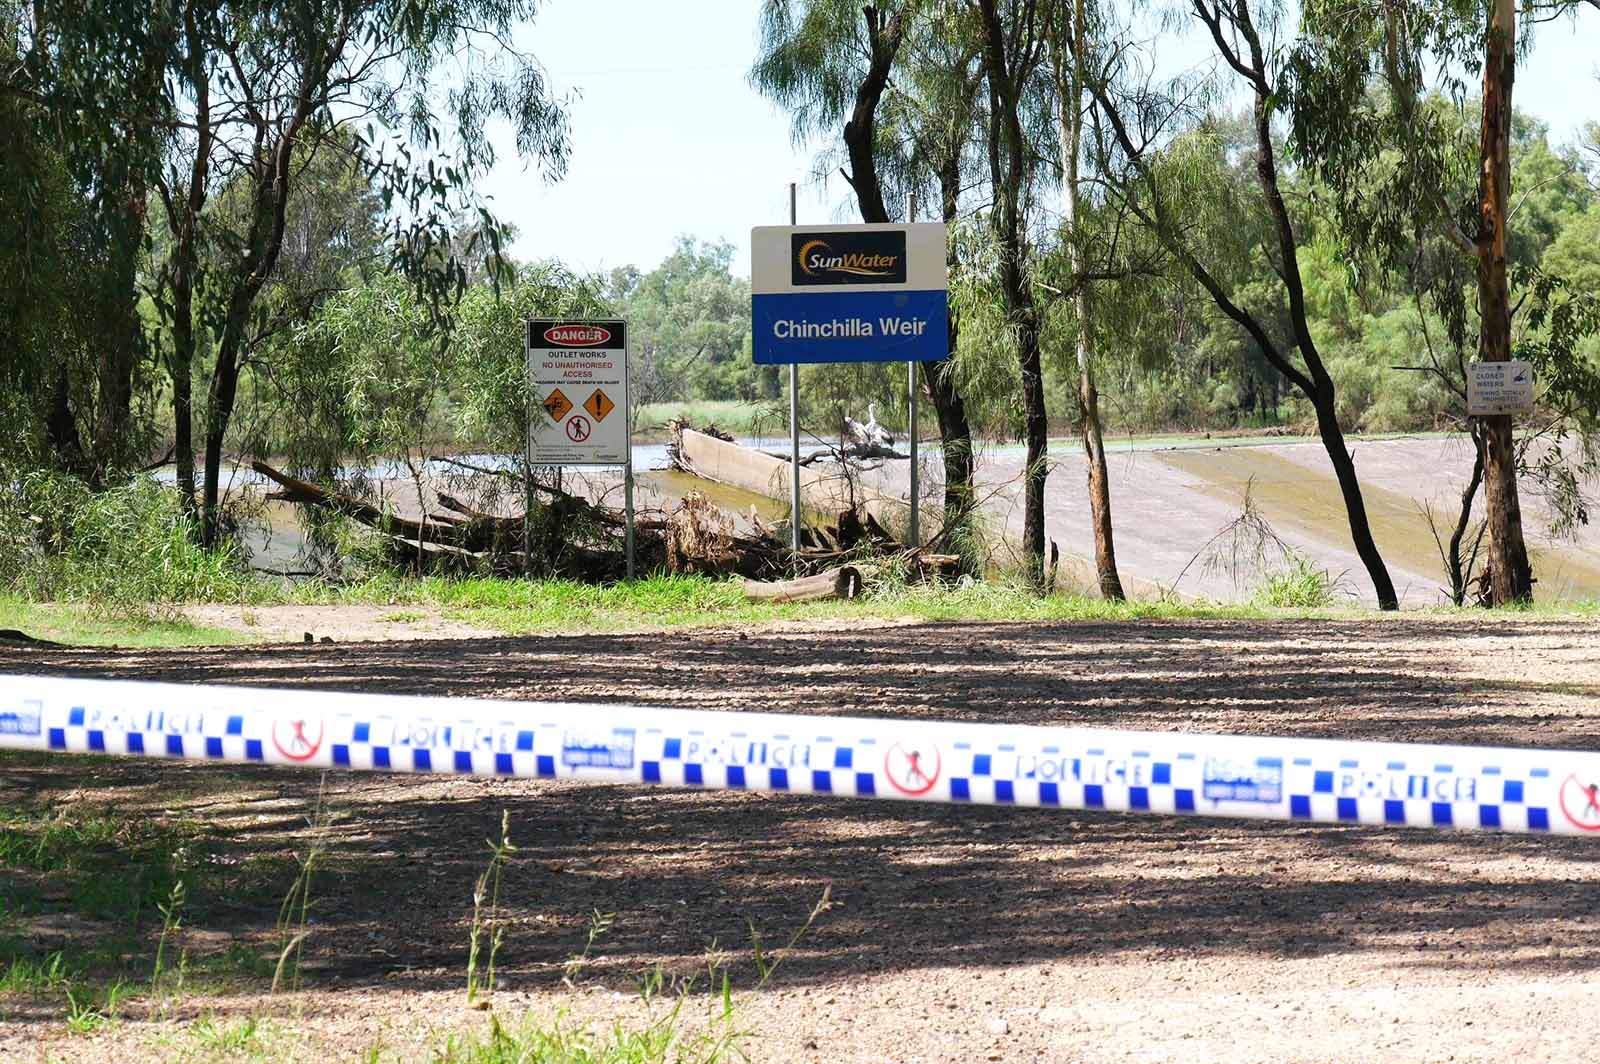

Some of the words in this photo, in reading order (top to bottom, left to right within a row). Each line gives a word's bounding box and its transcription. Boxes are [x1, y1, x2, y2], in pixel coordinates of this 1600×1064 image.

[808, 253, 898, 269] SunWater
[552, 330, 602, 341] DANGER
[773, 317, 873, 339] Chinchilla
[879, 316, 927, 336] Weir
